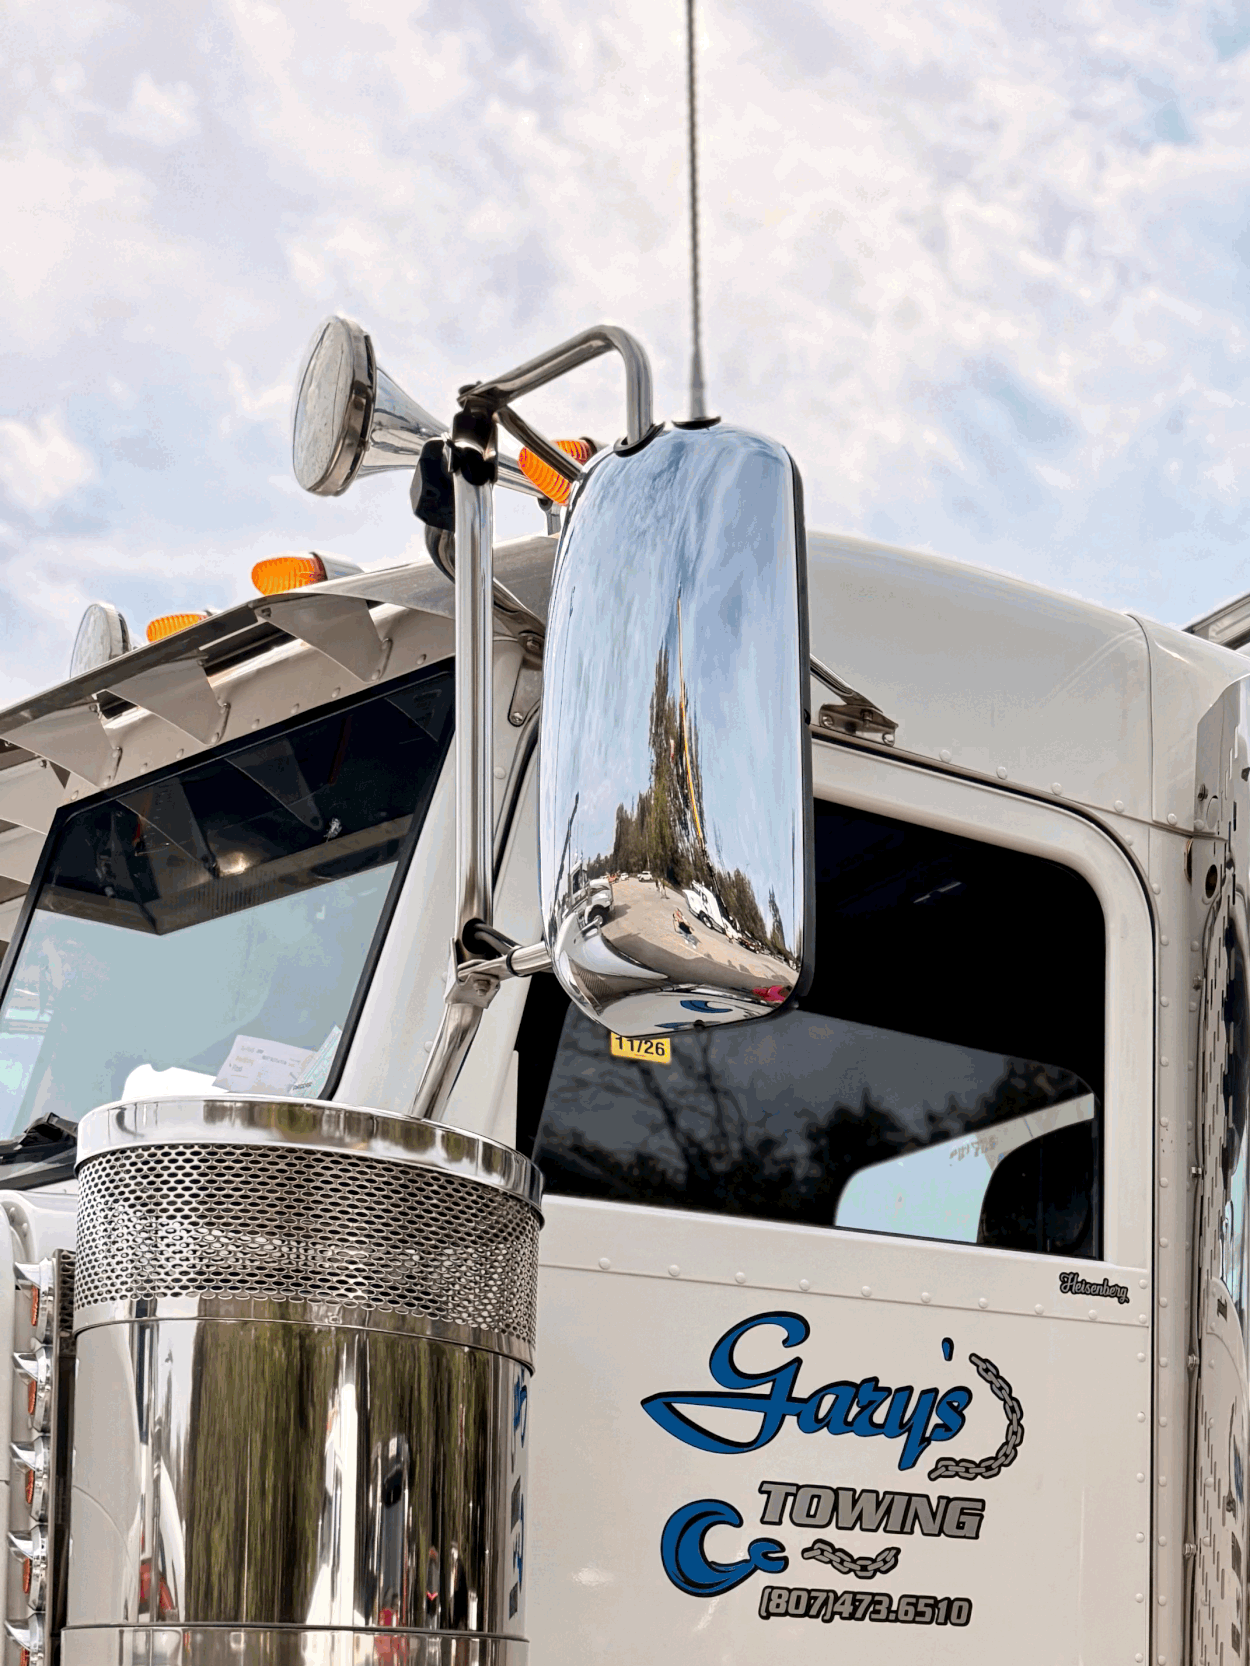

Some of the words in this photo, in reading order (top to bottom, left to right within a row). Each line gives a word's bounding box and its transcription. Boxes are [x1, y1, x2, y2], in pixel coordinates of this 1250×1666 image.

[615, 1036, 665, 1056] 11/26
[1059, 1271, 1130, 1304] Heisenberg
[641, 1311, 973, 1471] Gary's
[758, 1481, 986, 1540] TOWING
[758, 1585, 973, 1627] (807)473.6510
